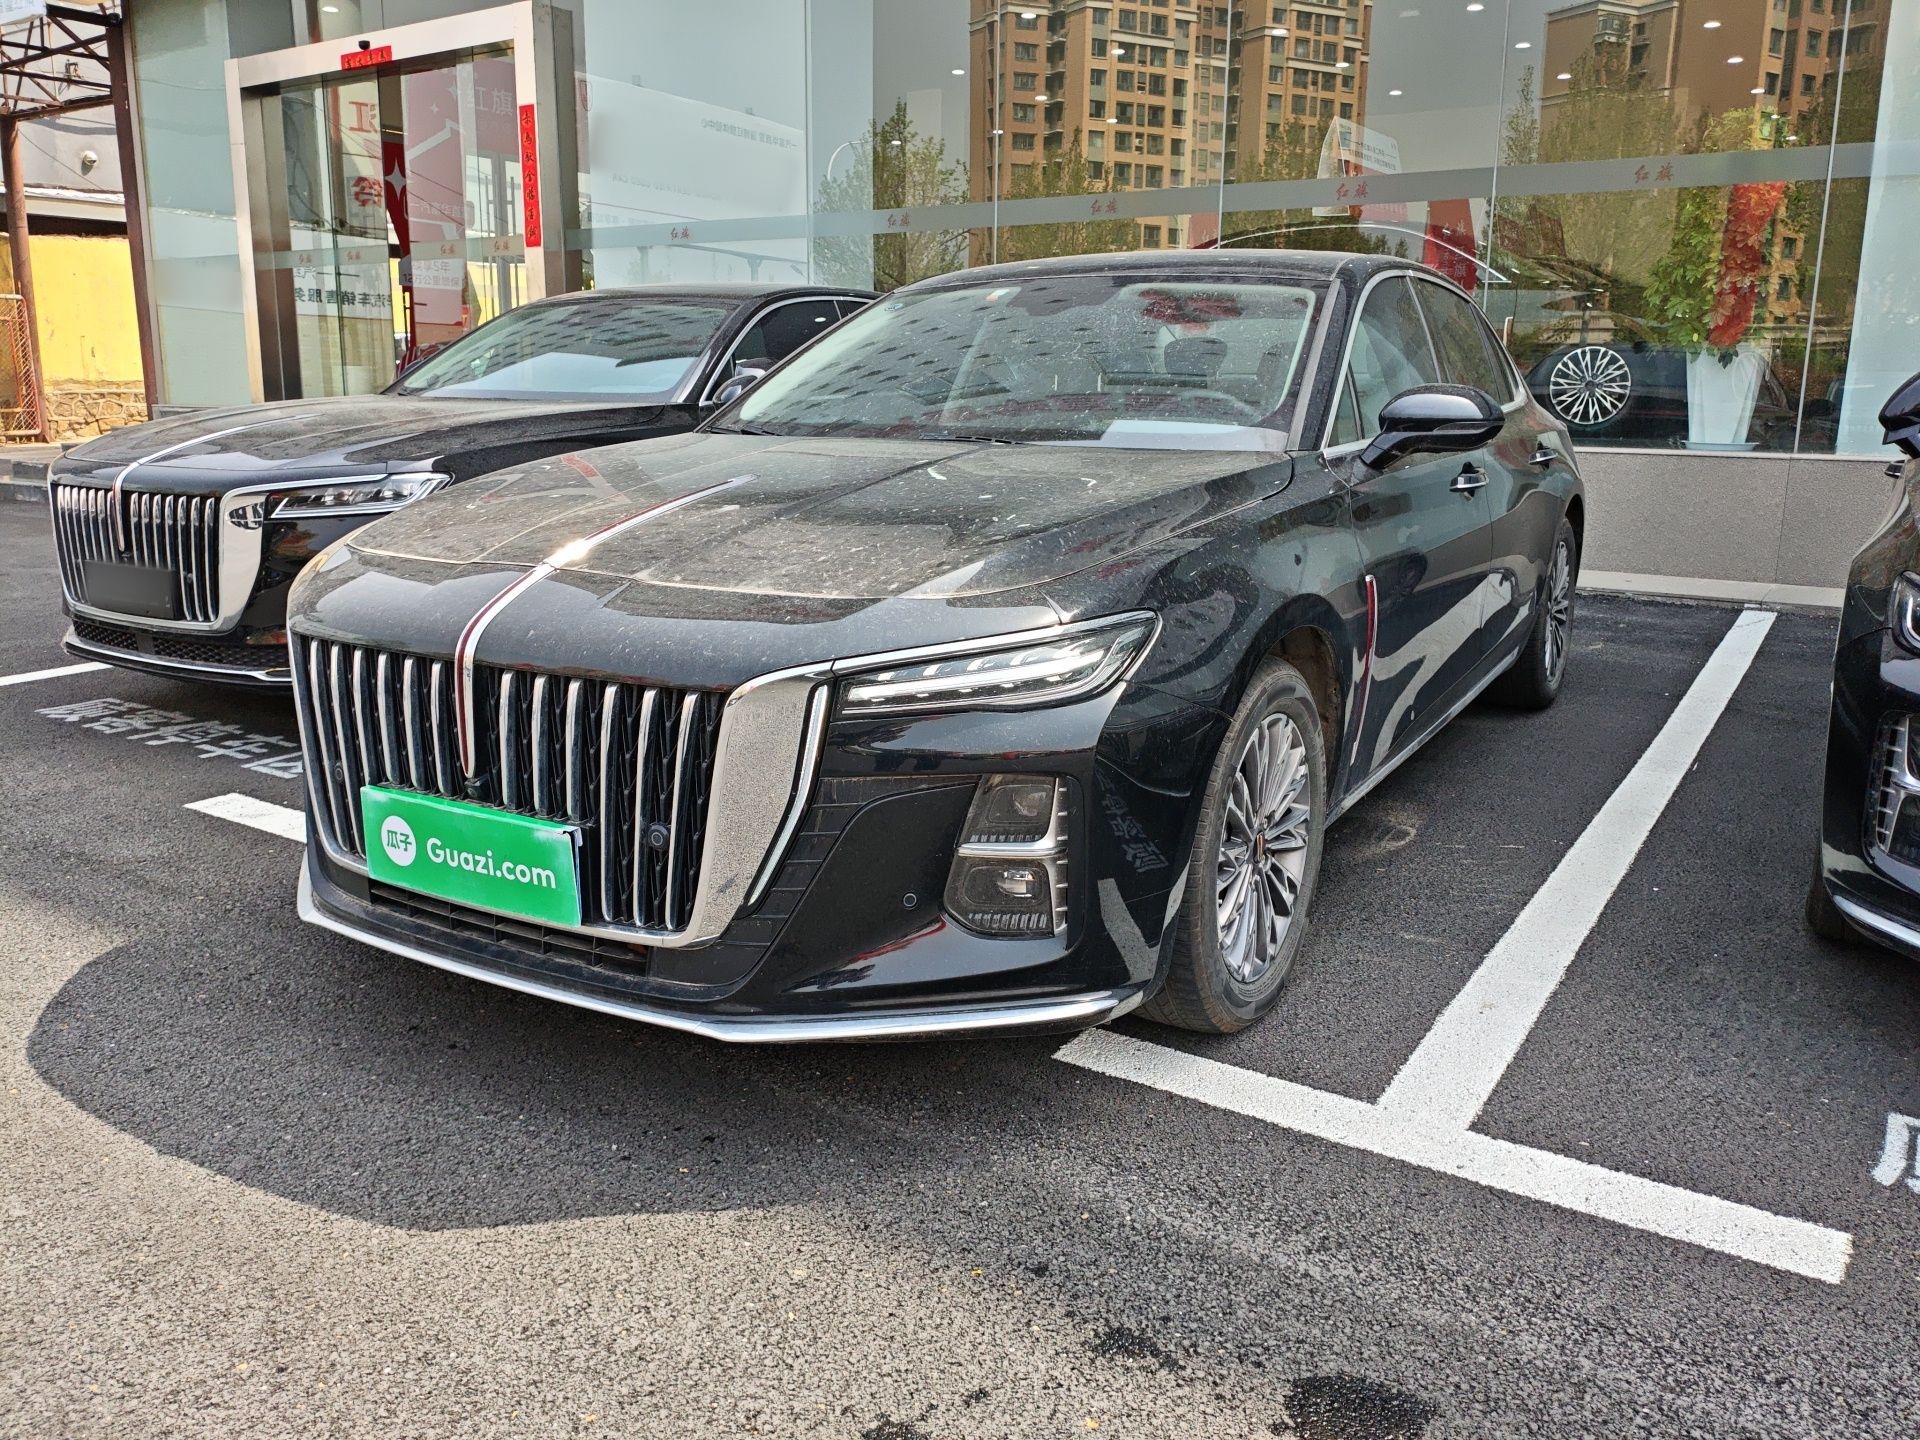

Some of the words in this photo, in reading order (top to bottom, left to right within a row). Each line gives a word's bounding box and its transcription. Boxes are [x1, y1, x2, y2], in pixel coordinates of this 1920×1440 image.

[1634, 163, 1674, 183] 红旗
[1335, 182, 1369, 201] 红旗
[1091, 198, 1118, 214] 红旗
[887, 212, 912, 228] 红旗
[670, 226, 691, 241] 红旗
[387, 829, 413, 852] 瓜子
[426, 838, 556, 889] Guazi.com
